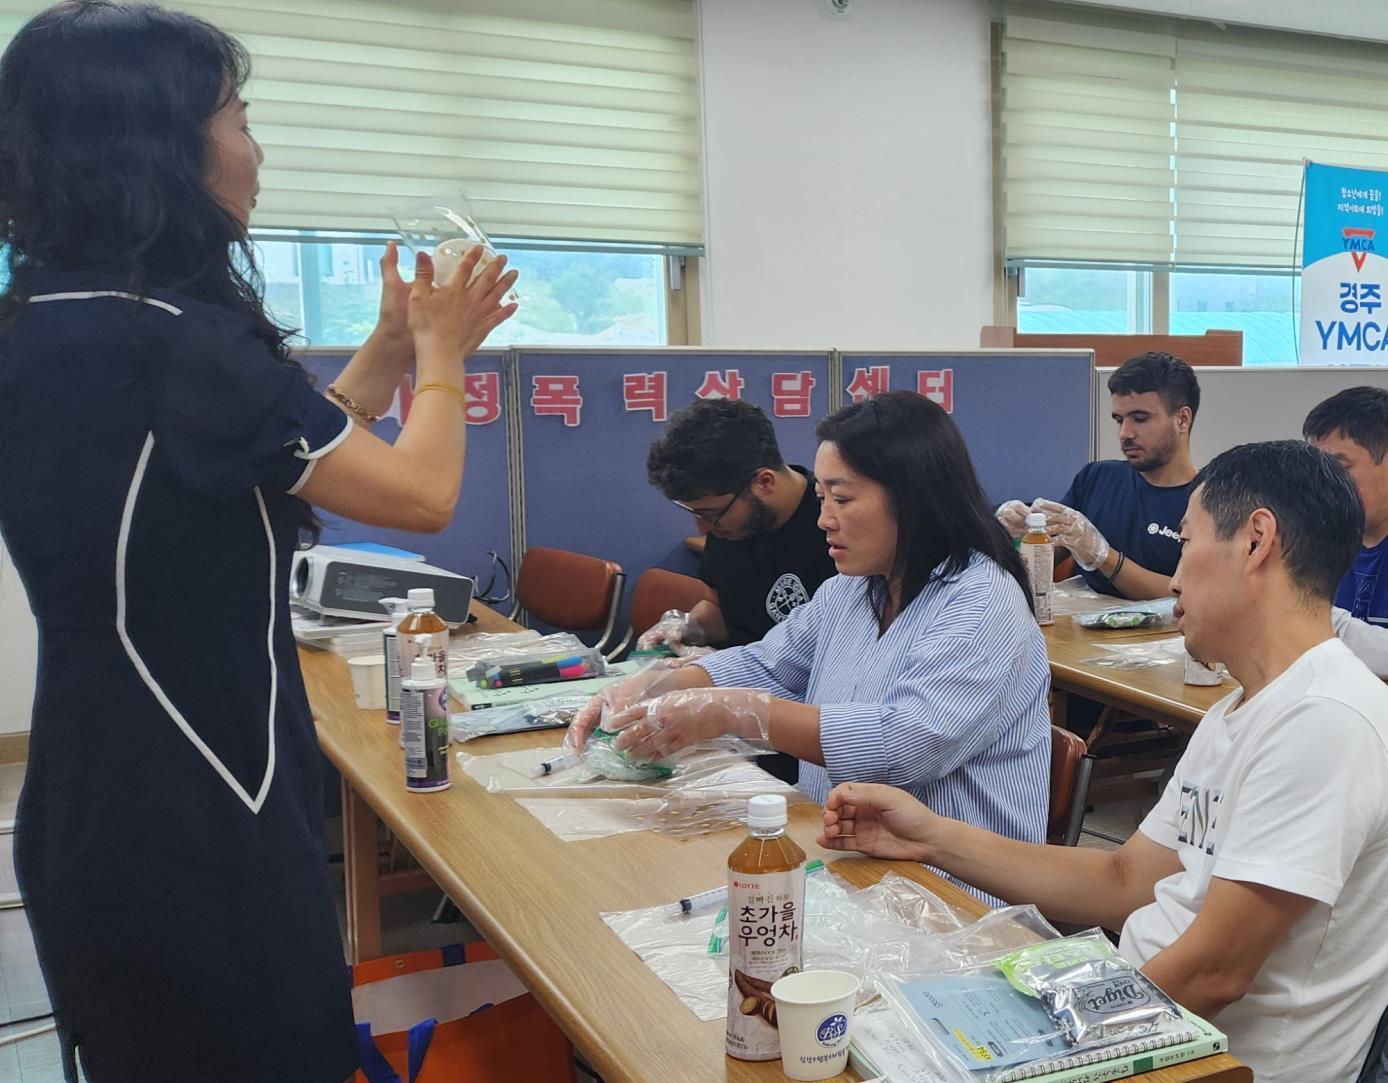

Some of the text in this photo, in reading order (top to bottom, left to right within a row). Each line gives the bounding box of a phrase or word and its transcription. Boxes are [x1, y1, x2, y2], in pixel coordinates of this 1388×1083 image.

[1342, 237, 1375, 252] YMCA
[1339, 282, 1382, 315] 경주
[1159, 525, 1181, 543] Jee
[739, 901, 797, 924] 초가을
[738, 920, 798, 947] 우엉차
[1087, 985, 1145, 1011] Diget
